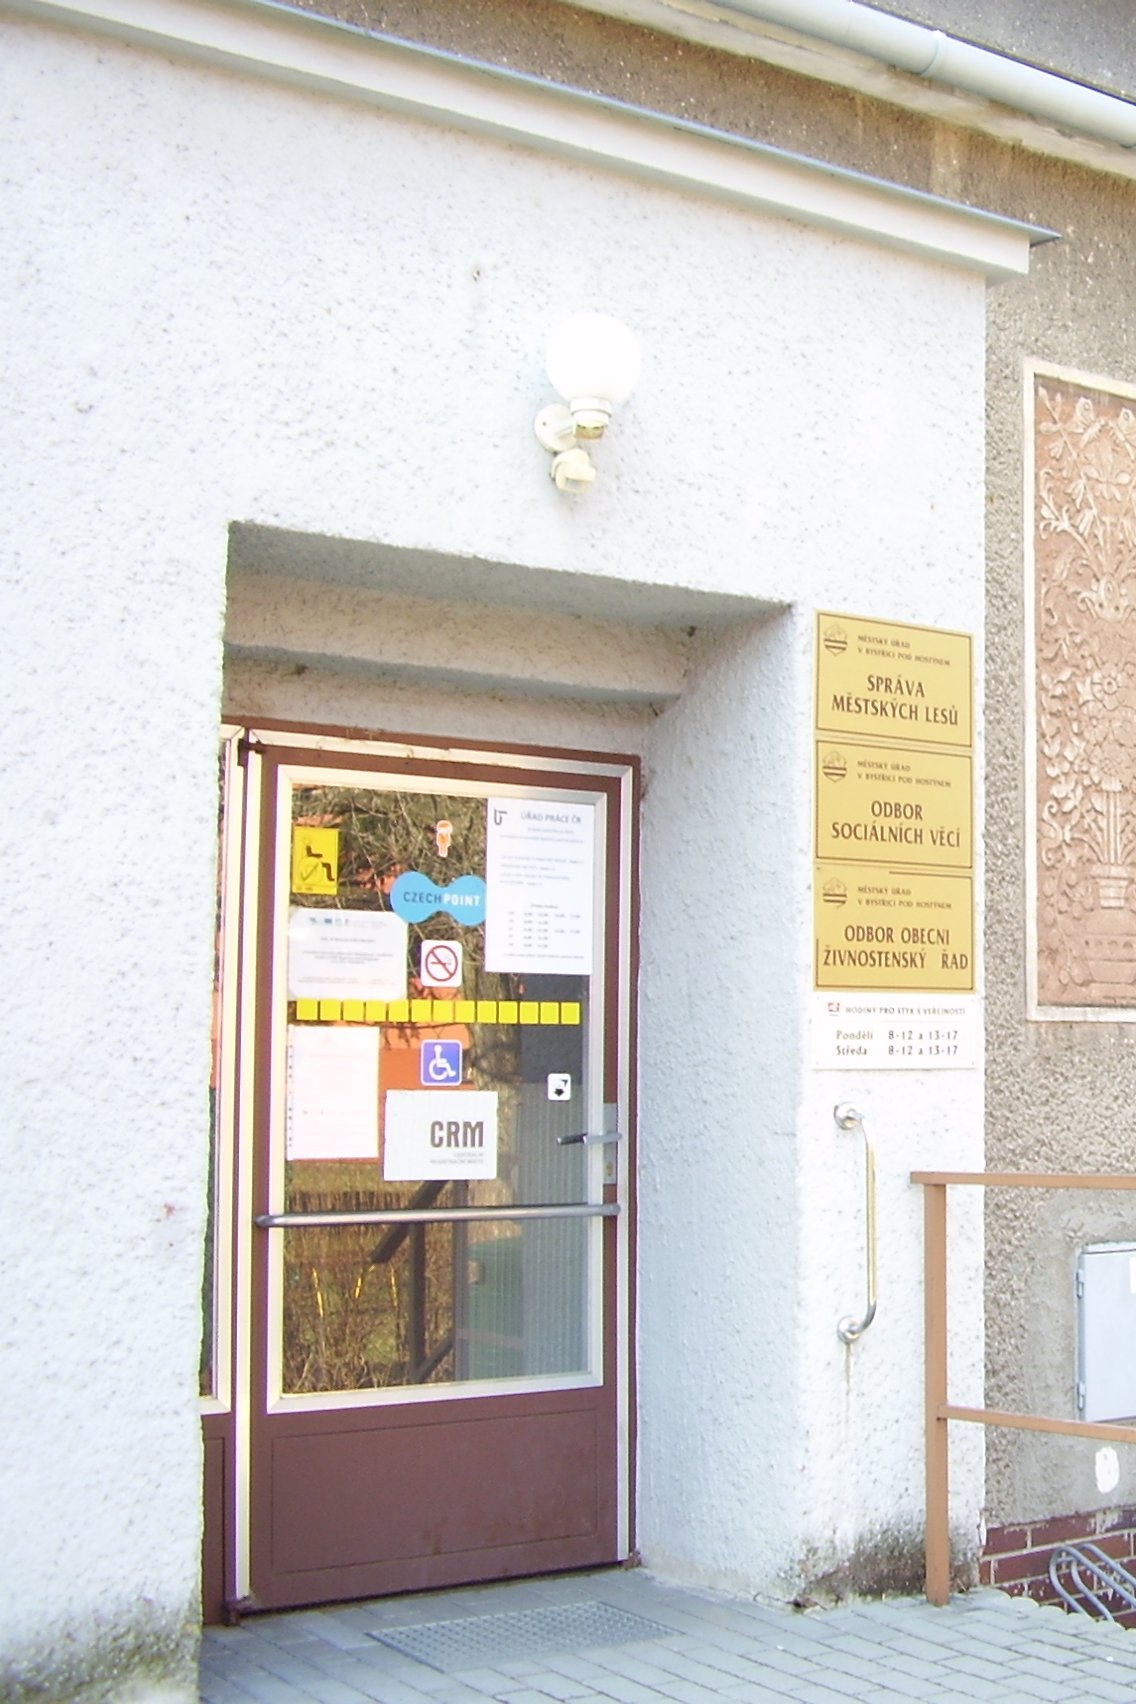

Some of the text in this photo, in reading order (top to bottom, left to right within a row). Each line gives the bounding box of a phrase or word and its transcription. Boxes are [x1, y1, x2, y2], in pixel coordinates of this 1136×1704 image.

[867, 674, 925, 698] SPRÁVA
[831, 691, 958, 726] MĚSTSKÝCH LESŮ
[871, 800, 923, 820] ODBOR
[831, 820, 960, 848] SOCIÁLNÍCH VĚCÍ
[844, 925, 894, 943] ODBOR
[823, 945, 926, 969] ŽIVNOSTENSKÝ
[845, 1006, 876, 1014] HODINY
[836, 1030, 874, 1040] Pondělí
[836, 1045, 868, 1056] Středa
[430, 1120, 484, 1148] CRM
